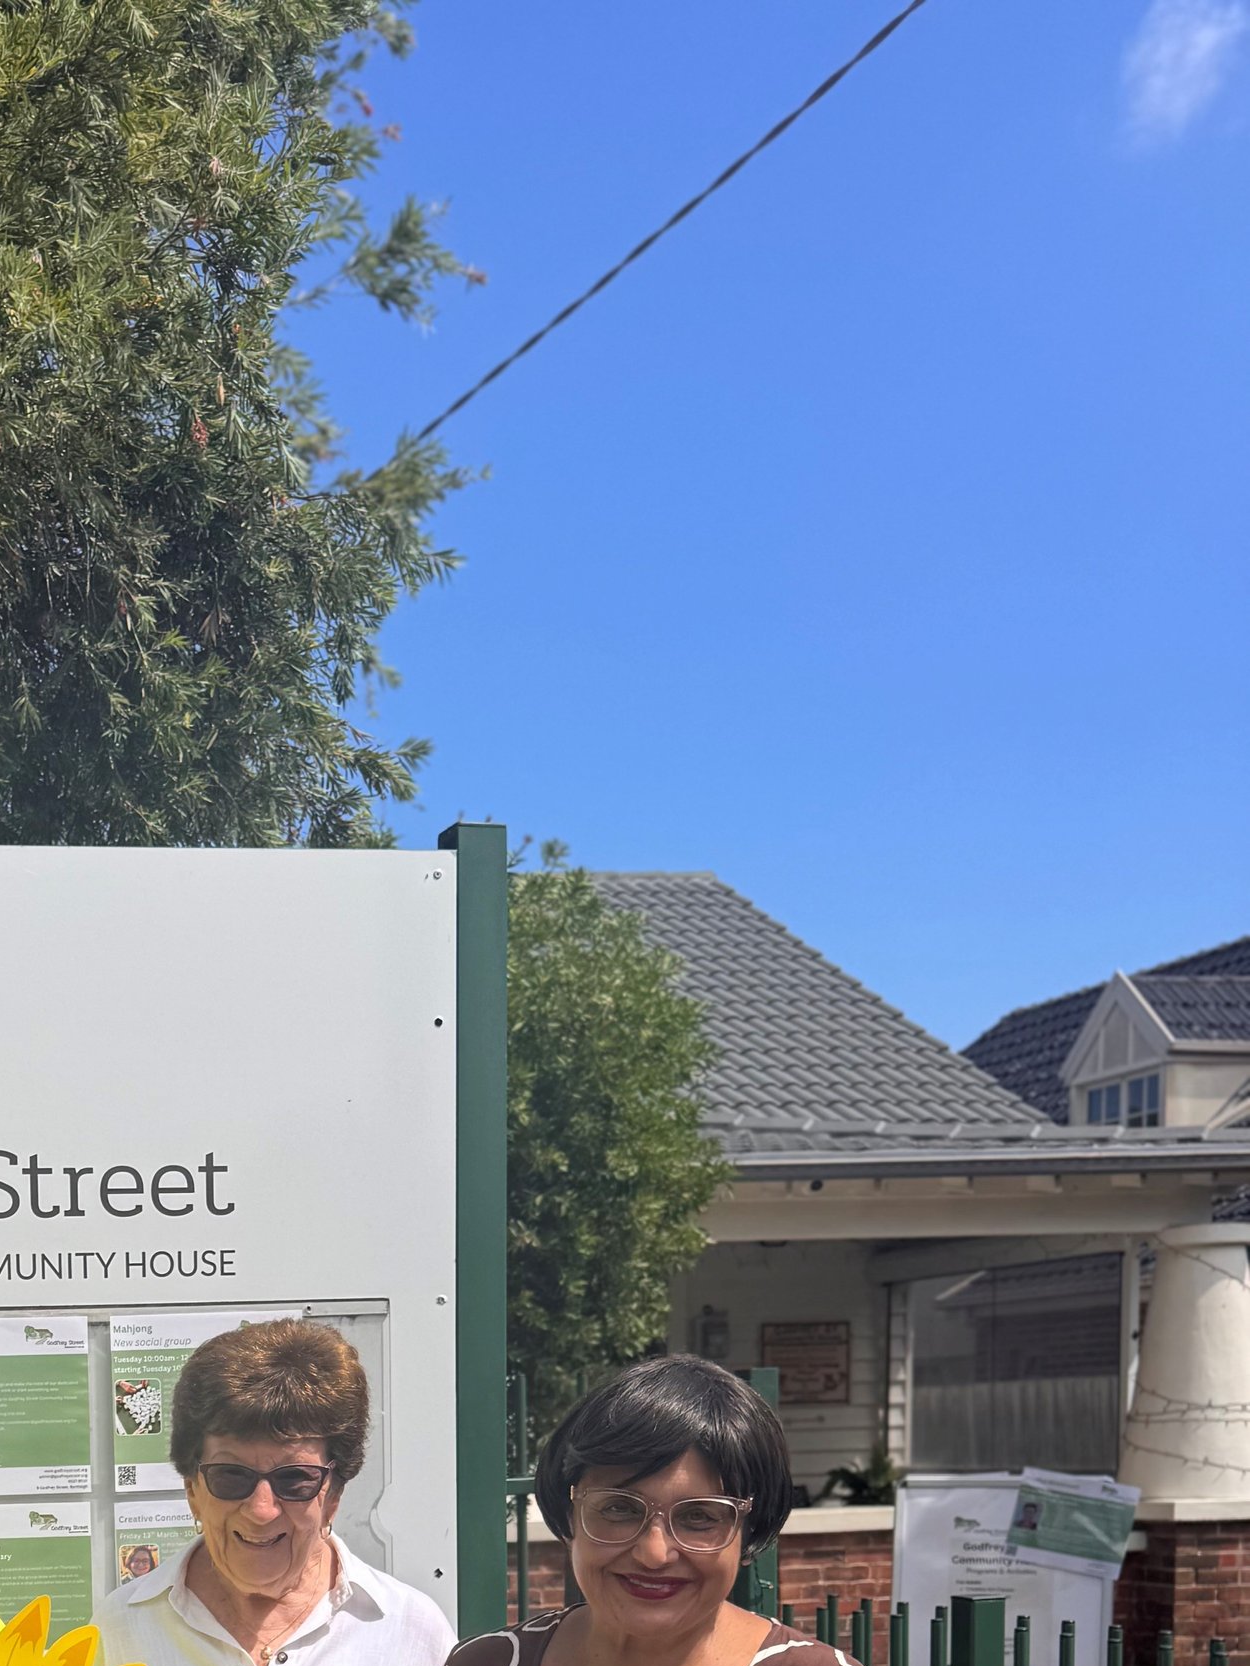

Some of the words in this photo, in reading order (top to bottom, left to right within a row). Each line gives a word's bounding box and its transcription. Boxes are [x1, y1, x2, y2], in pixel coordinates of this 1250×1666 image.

[126, 1249, 236, 1279] HOUSE
[113, 1324, 153, 1335] Mahjong
[113, 1340, 133, 1348] New
[135, 1338, 162, 1347] social
[163, 1338, 192, 1348] group
[113, 1356, 143, 1364] Tuesday
[143, 1355, 175, 1363] 10:00am
[119, 1515, 153, 1523] Creative
[963, 1543, 1005, 1552] Godfrey
[951, 1556, 1015, 1567] Community
